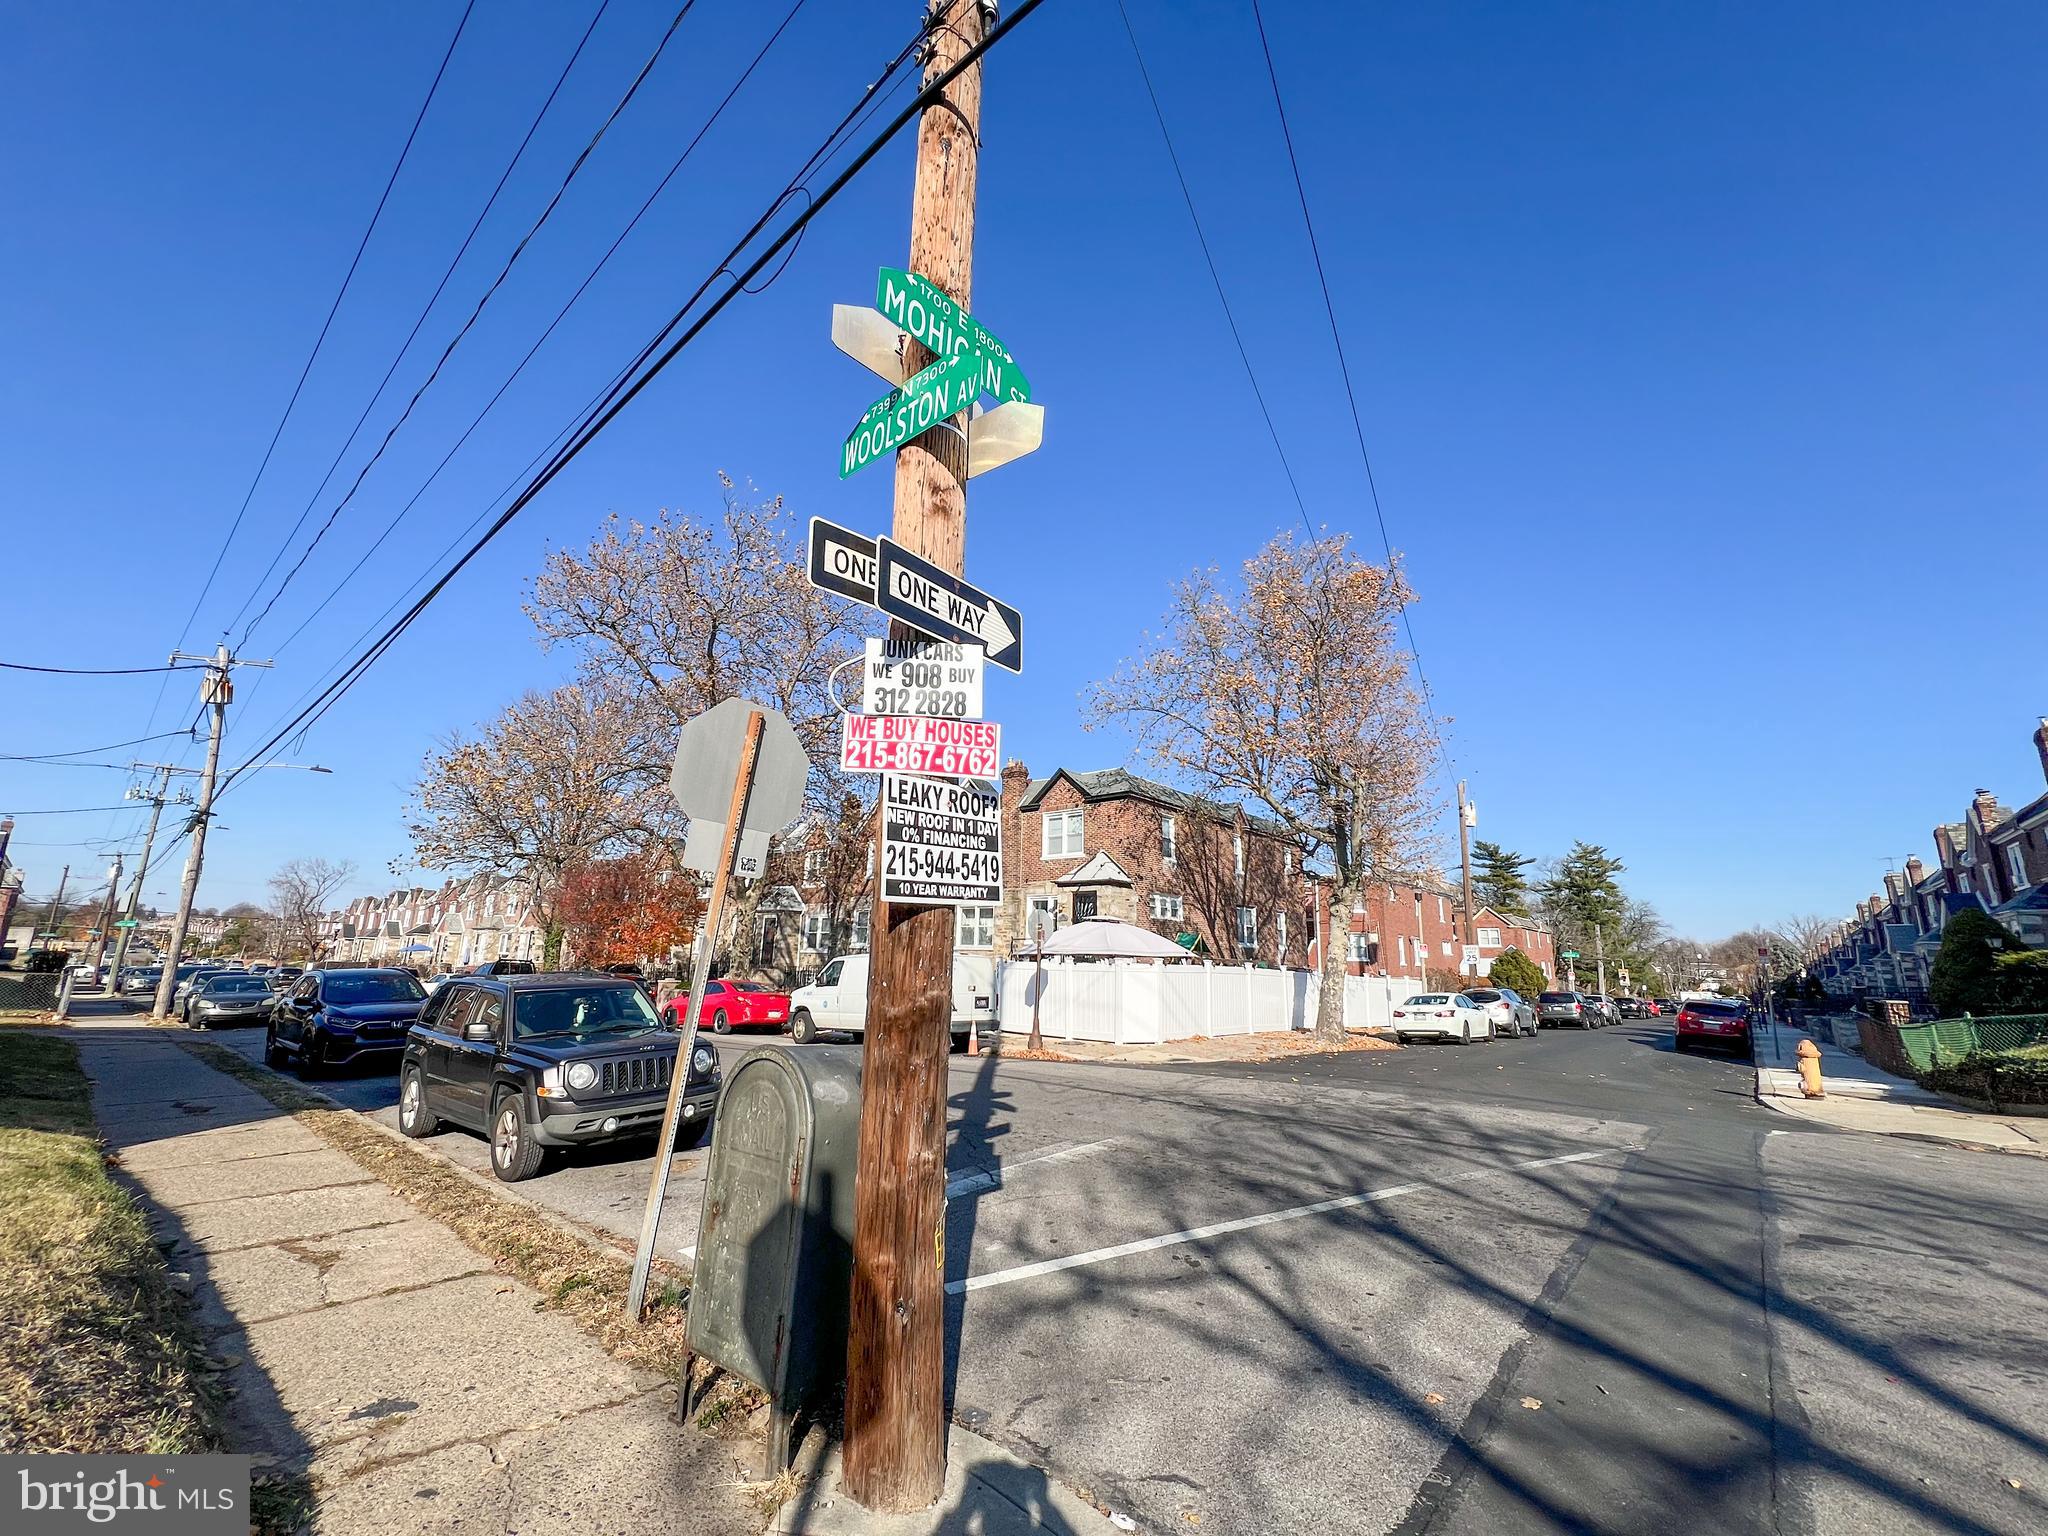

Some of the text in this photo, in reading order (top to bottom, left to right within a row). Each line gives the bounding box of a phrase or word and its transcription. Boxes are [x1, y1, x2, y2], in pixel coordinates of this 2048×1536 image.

[920, 283, 1003, 357] 1700 E 1800
[871, 361, 947, 418] 7399 N 7300
[845, 372, 978, 474] WOOLSTON AV
[834, 549, 876, 586] ONE
[898, 571, 986, 634] ONE WAY
[879, 640, 964, 662] JUNK CARS
[873, 662, 976, 689] WE 908 BUY
[874, 687, 967, 717] 312 2828
[850, 716, 995, 748] WE BUY HOUSES
[846, 740, 995, 776] 215-867-6762
[888, 777, 998, 819] LEAKY ROOF?
[888, 807, 998, 837] NEW ROOF IN 1 DAY
[901, 826, 987, 850] 0% FINANCING
[886, 844, 999, 882] 215-944-5419
[898, 882, 988, 899] 10 YEAR WARRANTY
